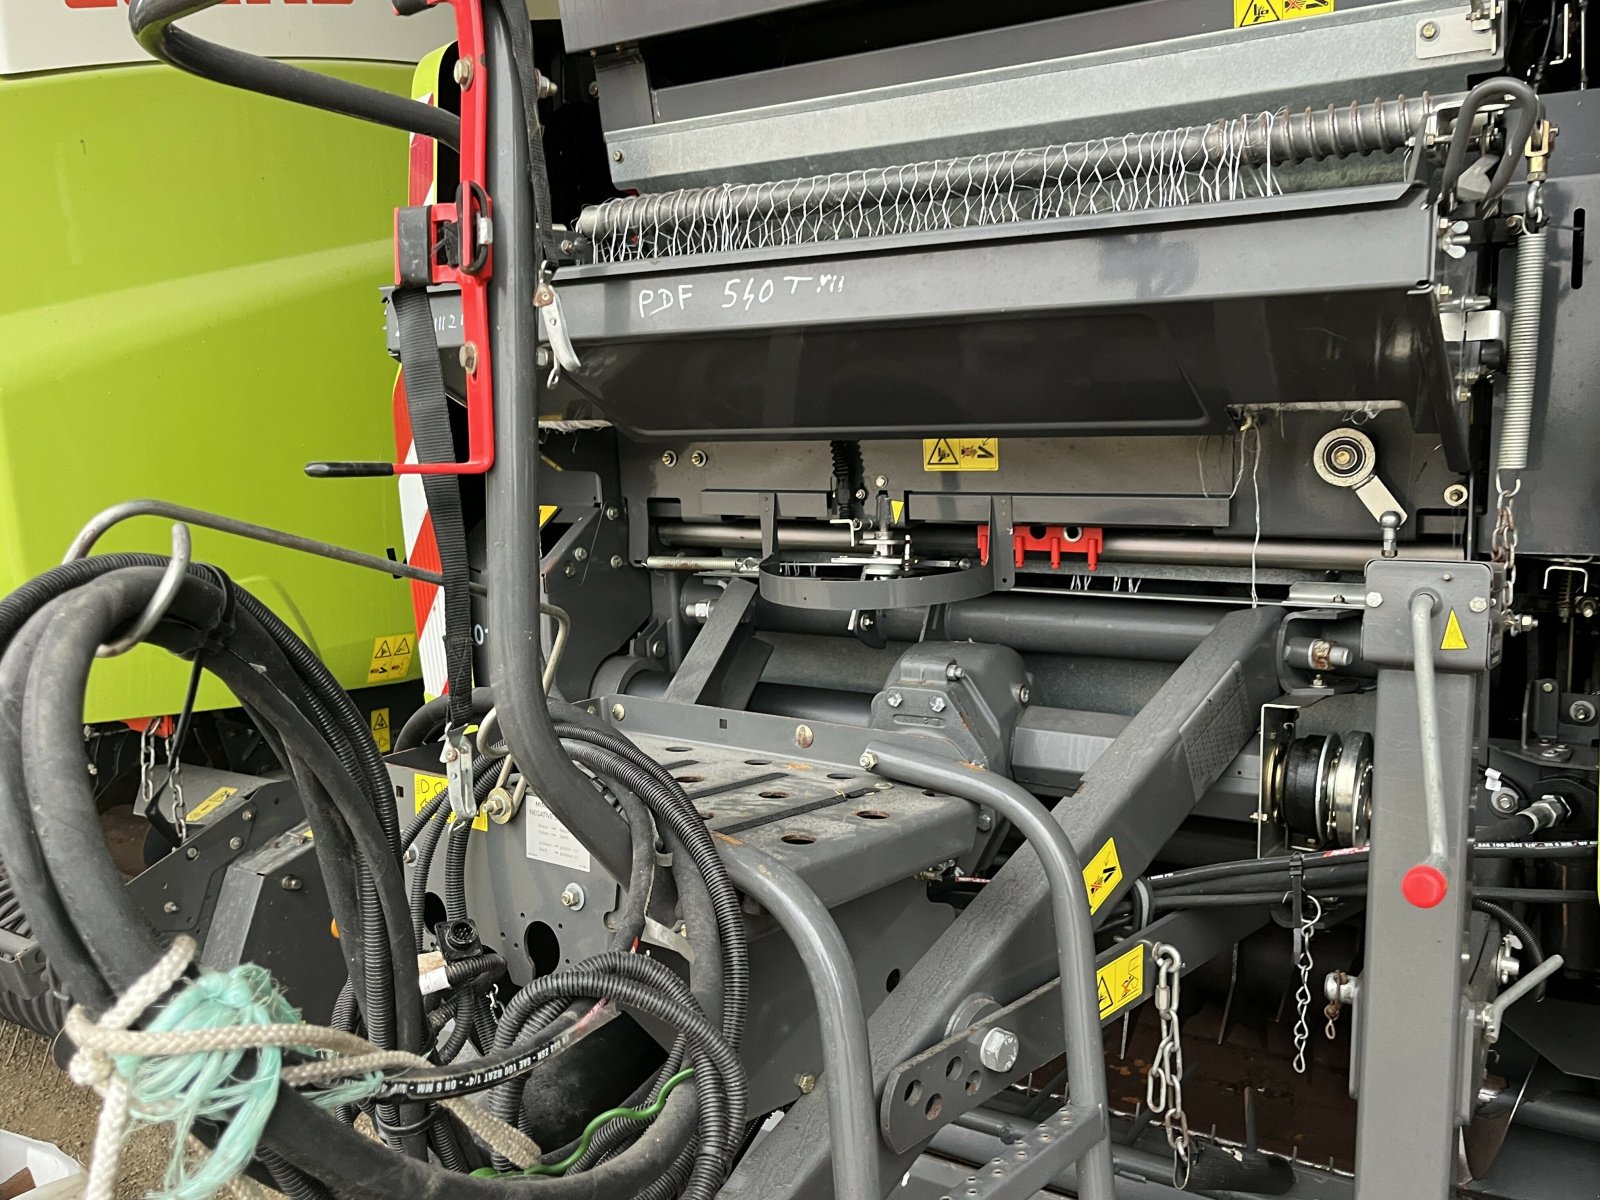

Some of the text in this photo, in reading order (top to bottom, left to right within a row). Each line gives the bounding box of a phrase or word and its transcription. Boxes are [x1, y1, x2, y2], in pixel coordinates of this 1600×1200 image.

[639, 284, 693, 318] PDF
[721, 278, 774, 311] 540
[504, 1062, 517, 1076] 100
[519, 1056, 532, 1070] SAE
[416, 1082, 434, 1094] MM
[436, 1082, 443, 1093] 6
